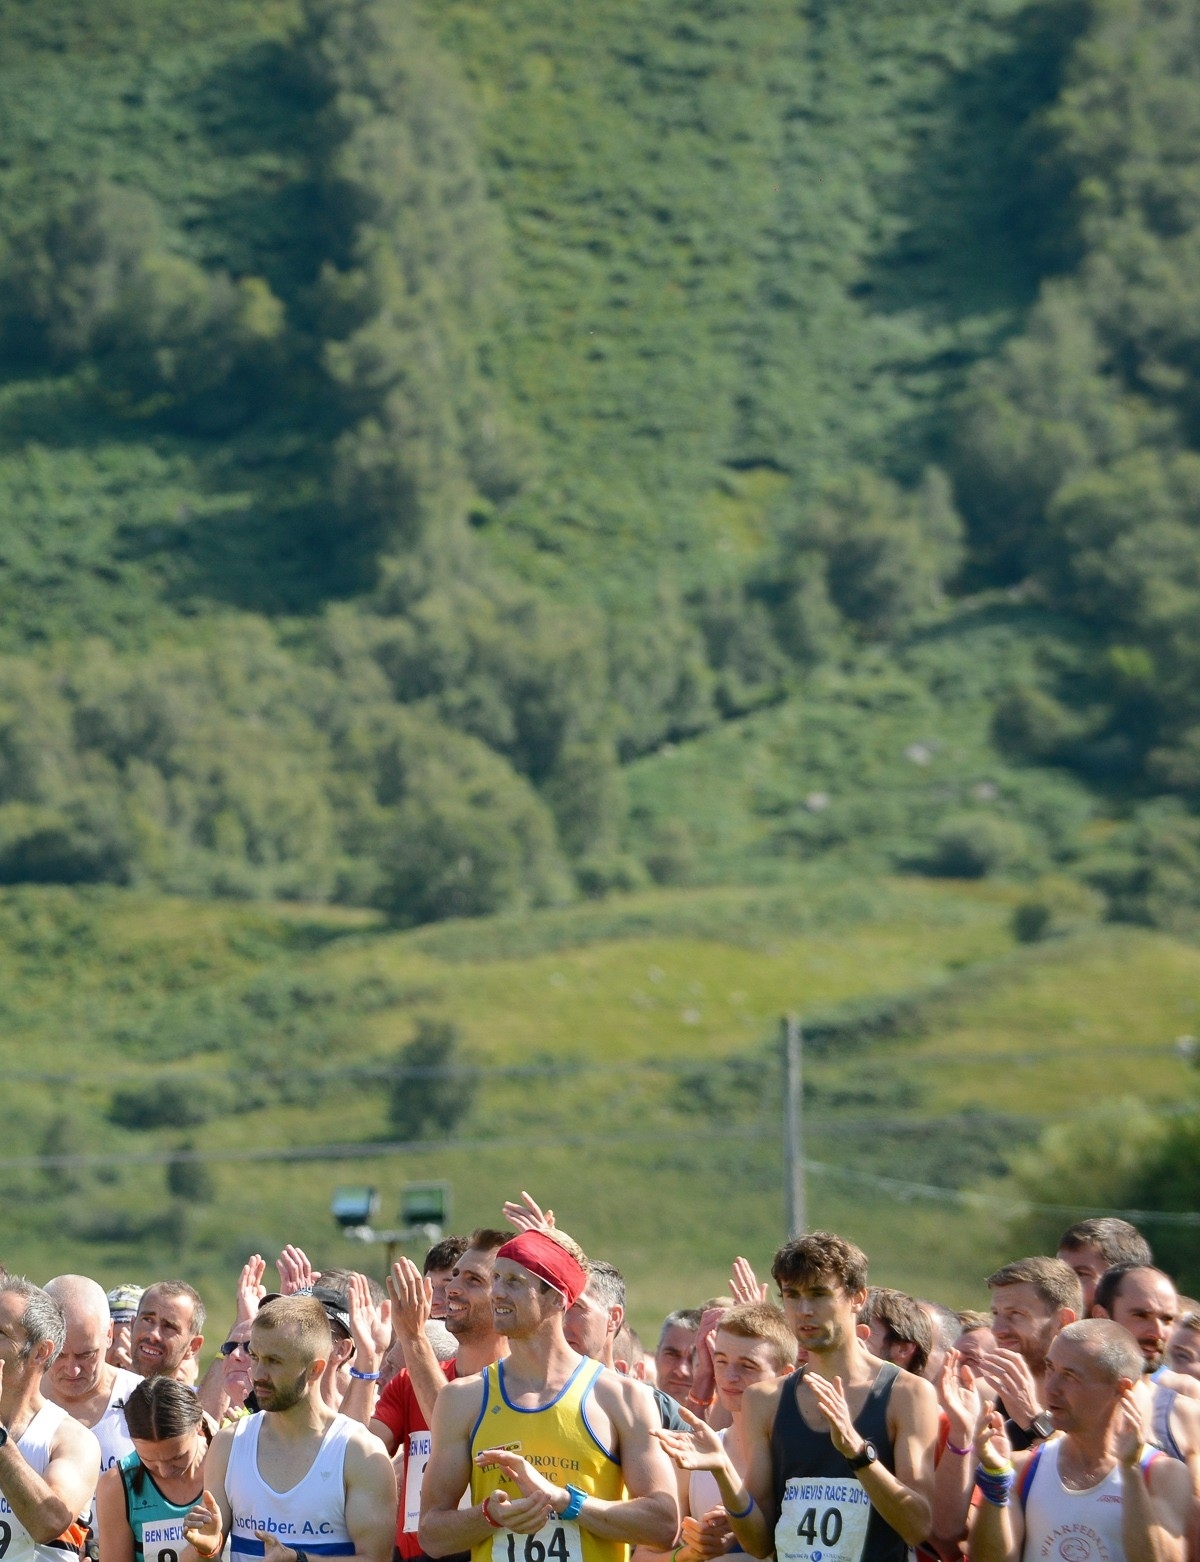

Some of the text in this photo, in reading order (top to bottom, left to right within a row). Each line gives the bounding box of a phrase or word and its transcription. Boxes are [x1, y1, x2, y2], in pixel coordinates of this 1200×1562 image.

[784, 1485, 869, 1505] BEN NEVIS RACE 2015
[145, 1528, 161, 1543] BEN
[302, 1520, 334, 1535] A.C.
[797, 1507, 843, 1547] 40
[507, 1527, 571, 1562] 164
